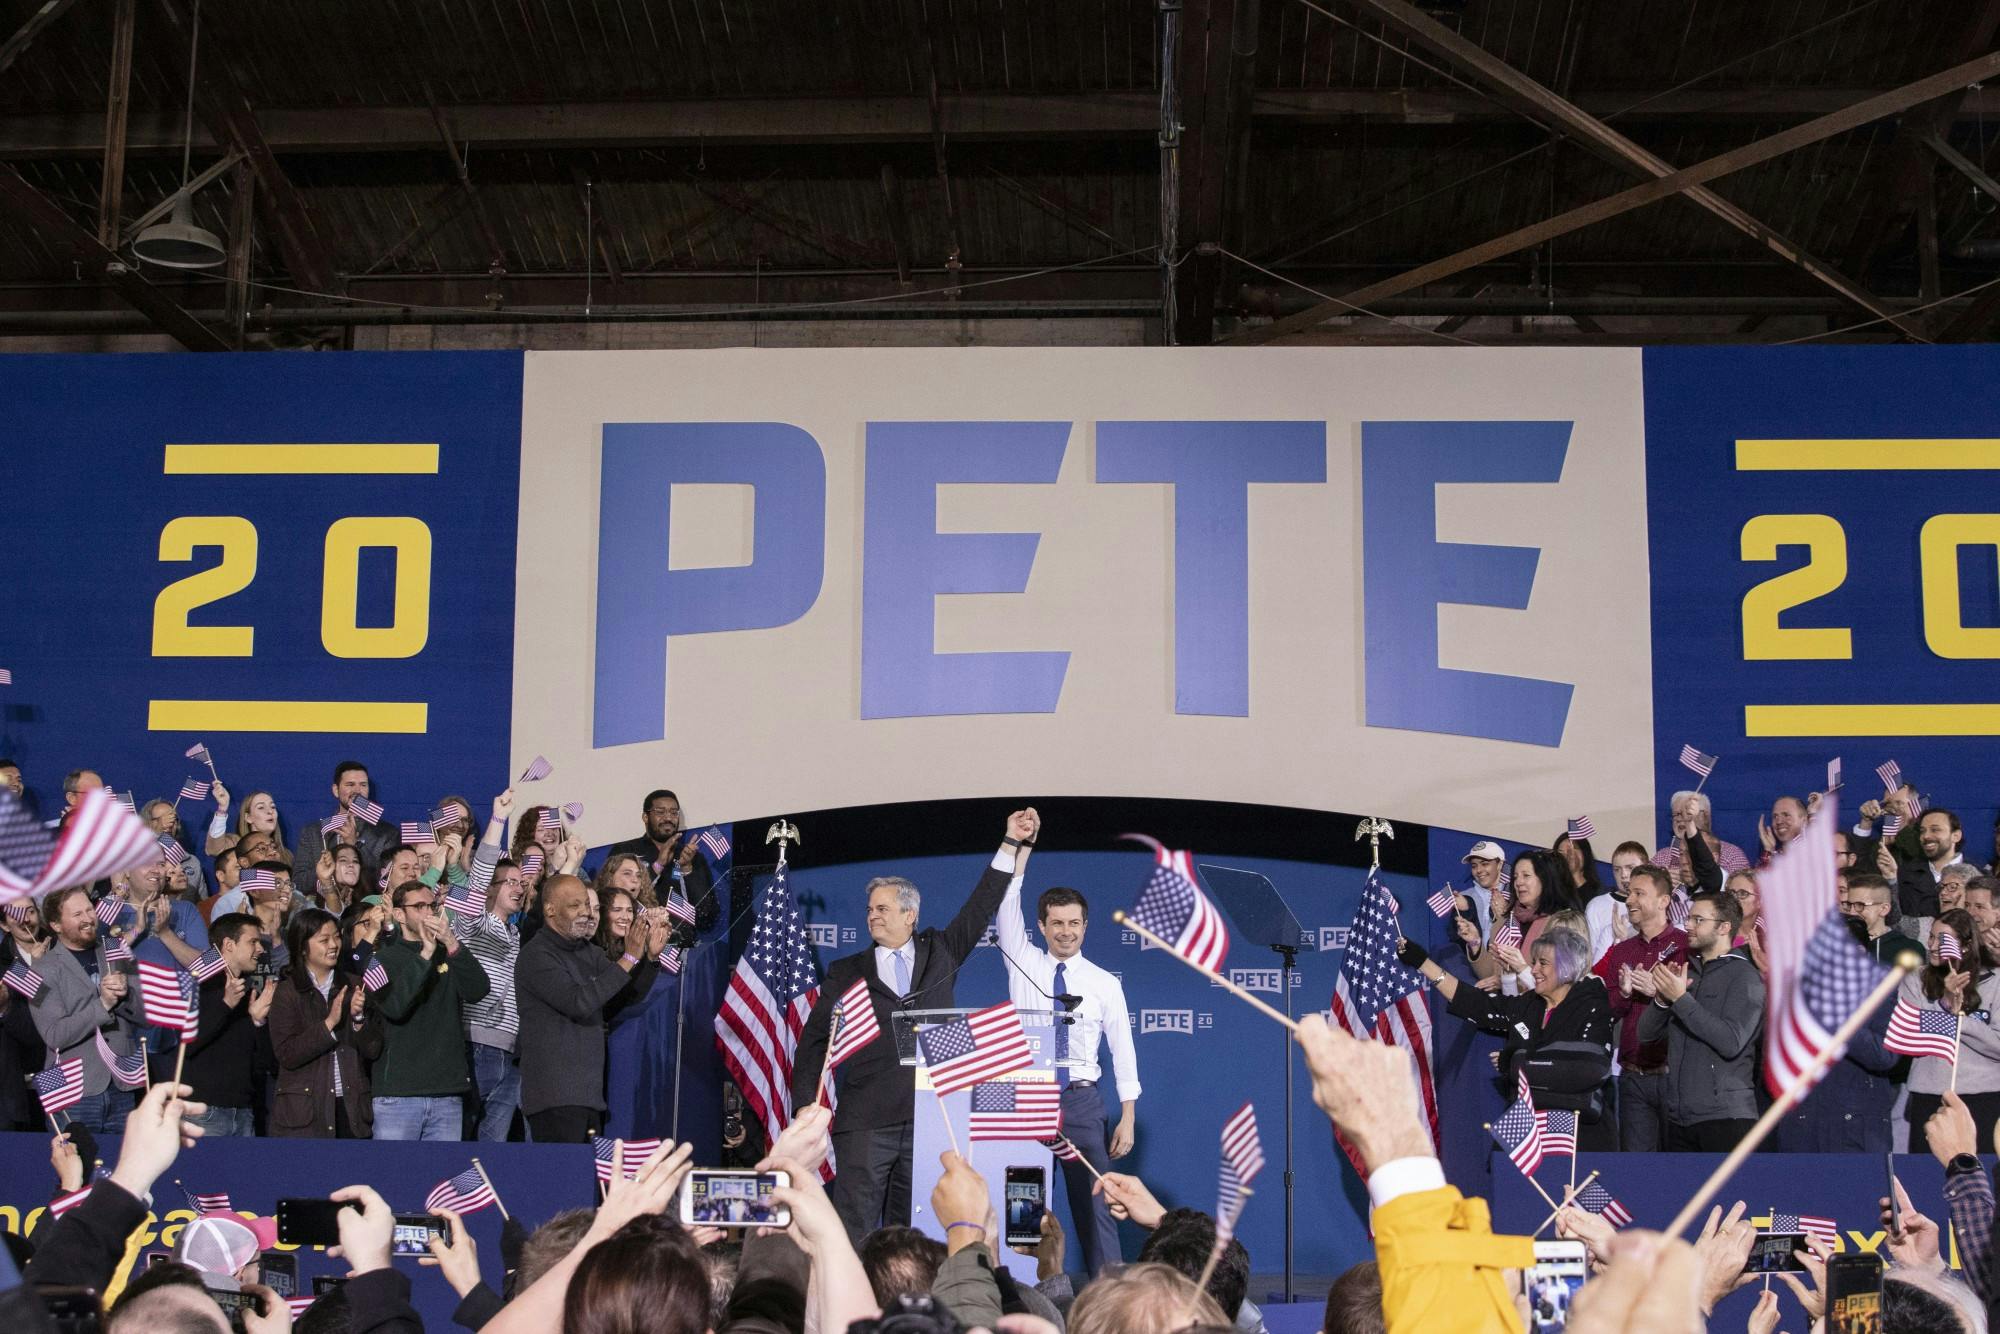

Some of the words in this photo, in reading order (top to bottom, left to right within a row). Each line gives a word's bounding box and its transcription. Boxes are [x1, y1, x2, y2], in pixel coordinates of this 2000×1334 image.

[152, 516, 432, 658] 20
[593, 421, 1575, 749] PETE
[1740, 514, 2000, 660] 20
[1121, 933, 1136, 941] 20
[1233, 972, 1279, 988] PETE
[1144, 1013, 1190, 1029] PETE
[1198, 1016, 1213, 1025] 20
